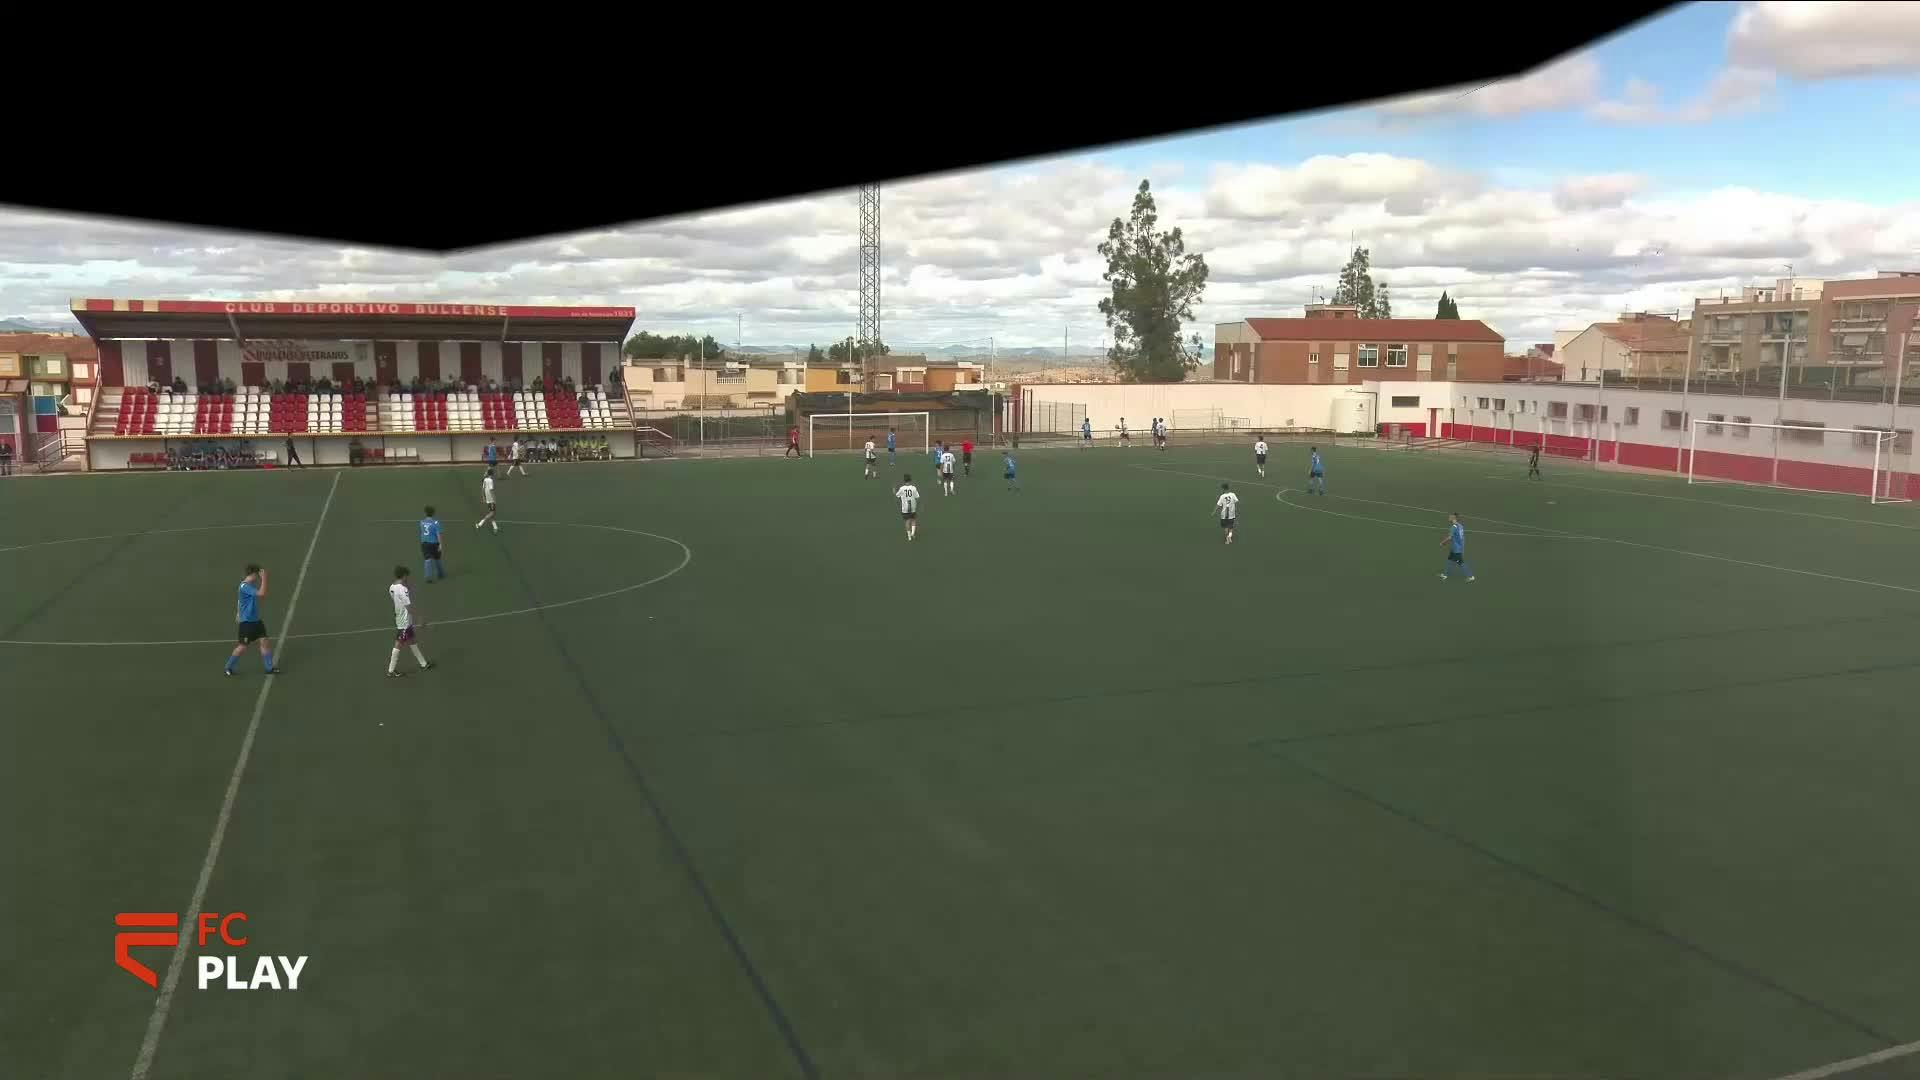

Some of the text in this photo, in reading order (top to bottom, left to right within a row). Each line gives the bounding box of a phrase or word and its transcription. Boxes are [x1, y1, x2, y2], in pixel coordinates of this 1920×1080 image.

[225, 302, 508, 317] CLUB DEPORTIVO BULLENSE
[903, 489, 913, 498] 10
[423, 525, 430, 536] 3
